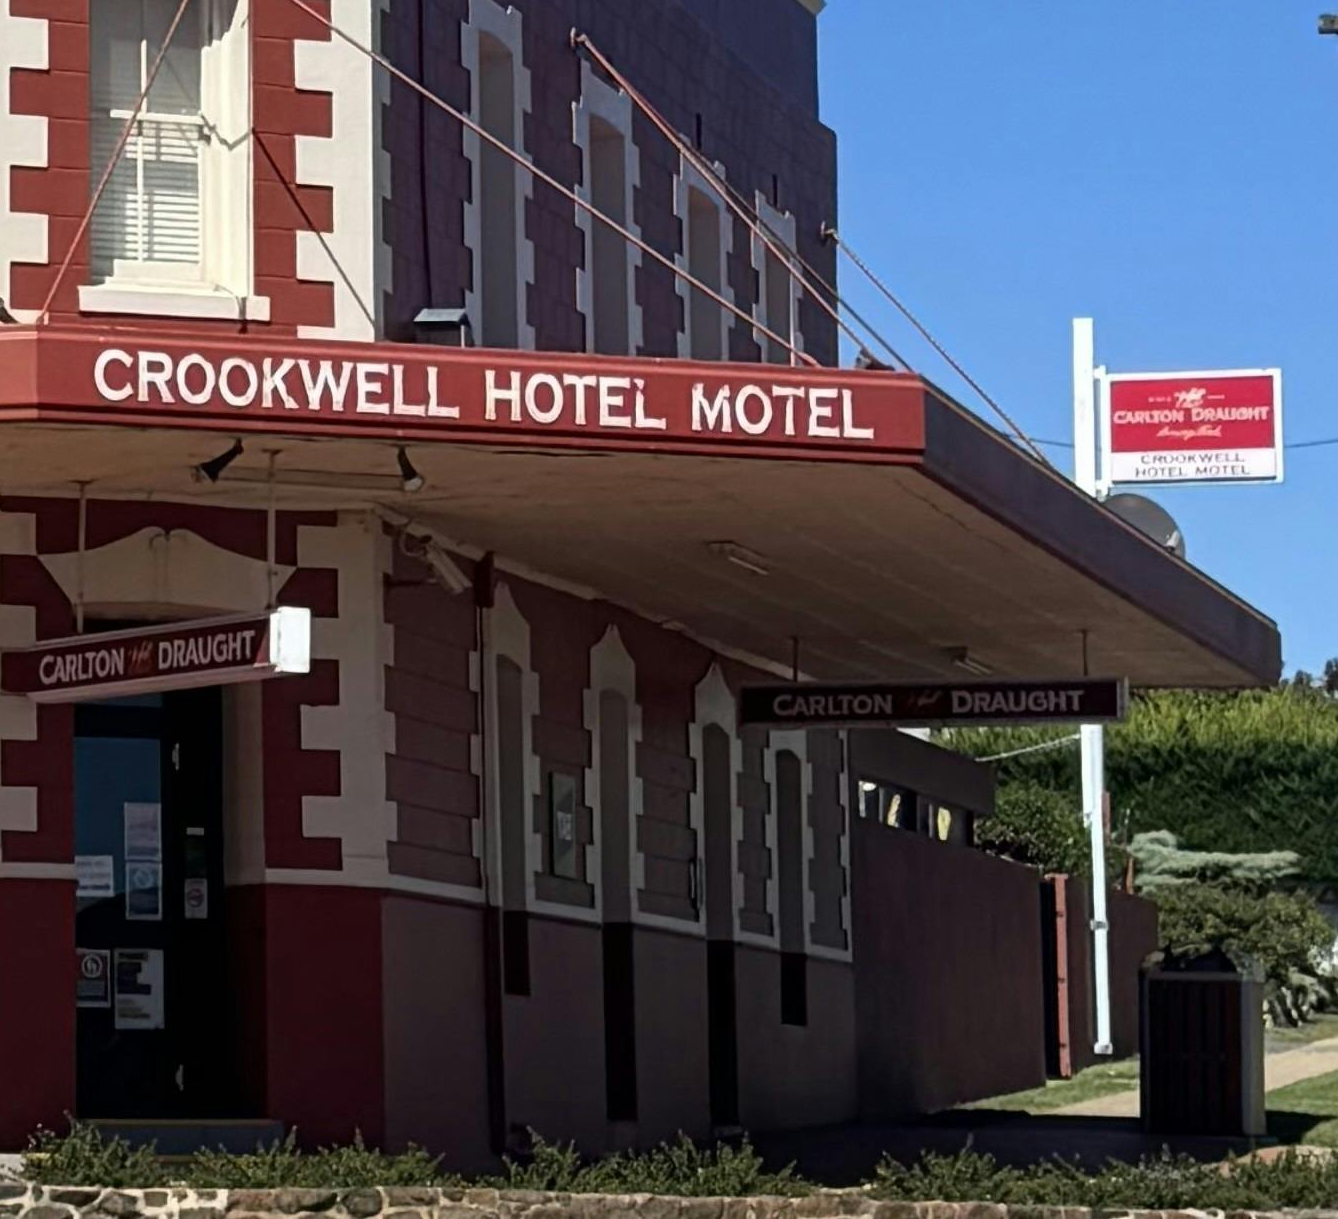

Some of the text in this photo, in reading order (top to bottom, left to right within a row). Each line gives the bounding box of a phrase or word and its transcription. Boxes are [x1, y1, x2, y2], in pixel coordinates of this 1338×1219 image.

[93, 348, 875, 440] CROOKWELL HOTEL MOTEL
[1113, 407, 1269, 424] CARLTON DRAUGHT
[1141, 452, 1246, 465] CROOKWELL
[1135, 464, 1251, 478] HOTEL MOTEL
[39, 630, 256, 685] CARLTON DRAUGHT
[772, 689, 1085, 717] CARLTON DRAUGHT
